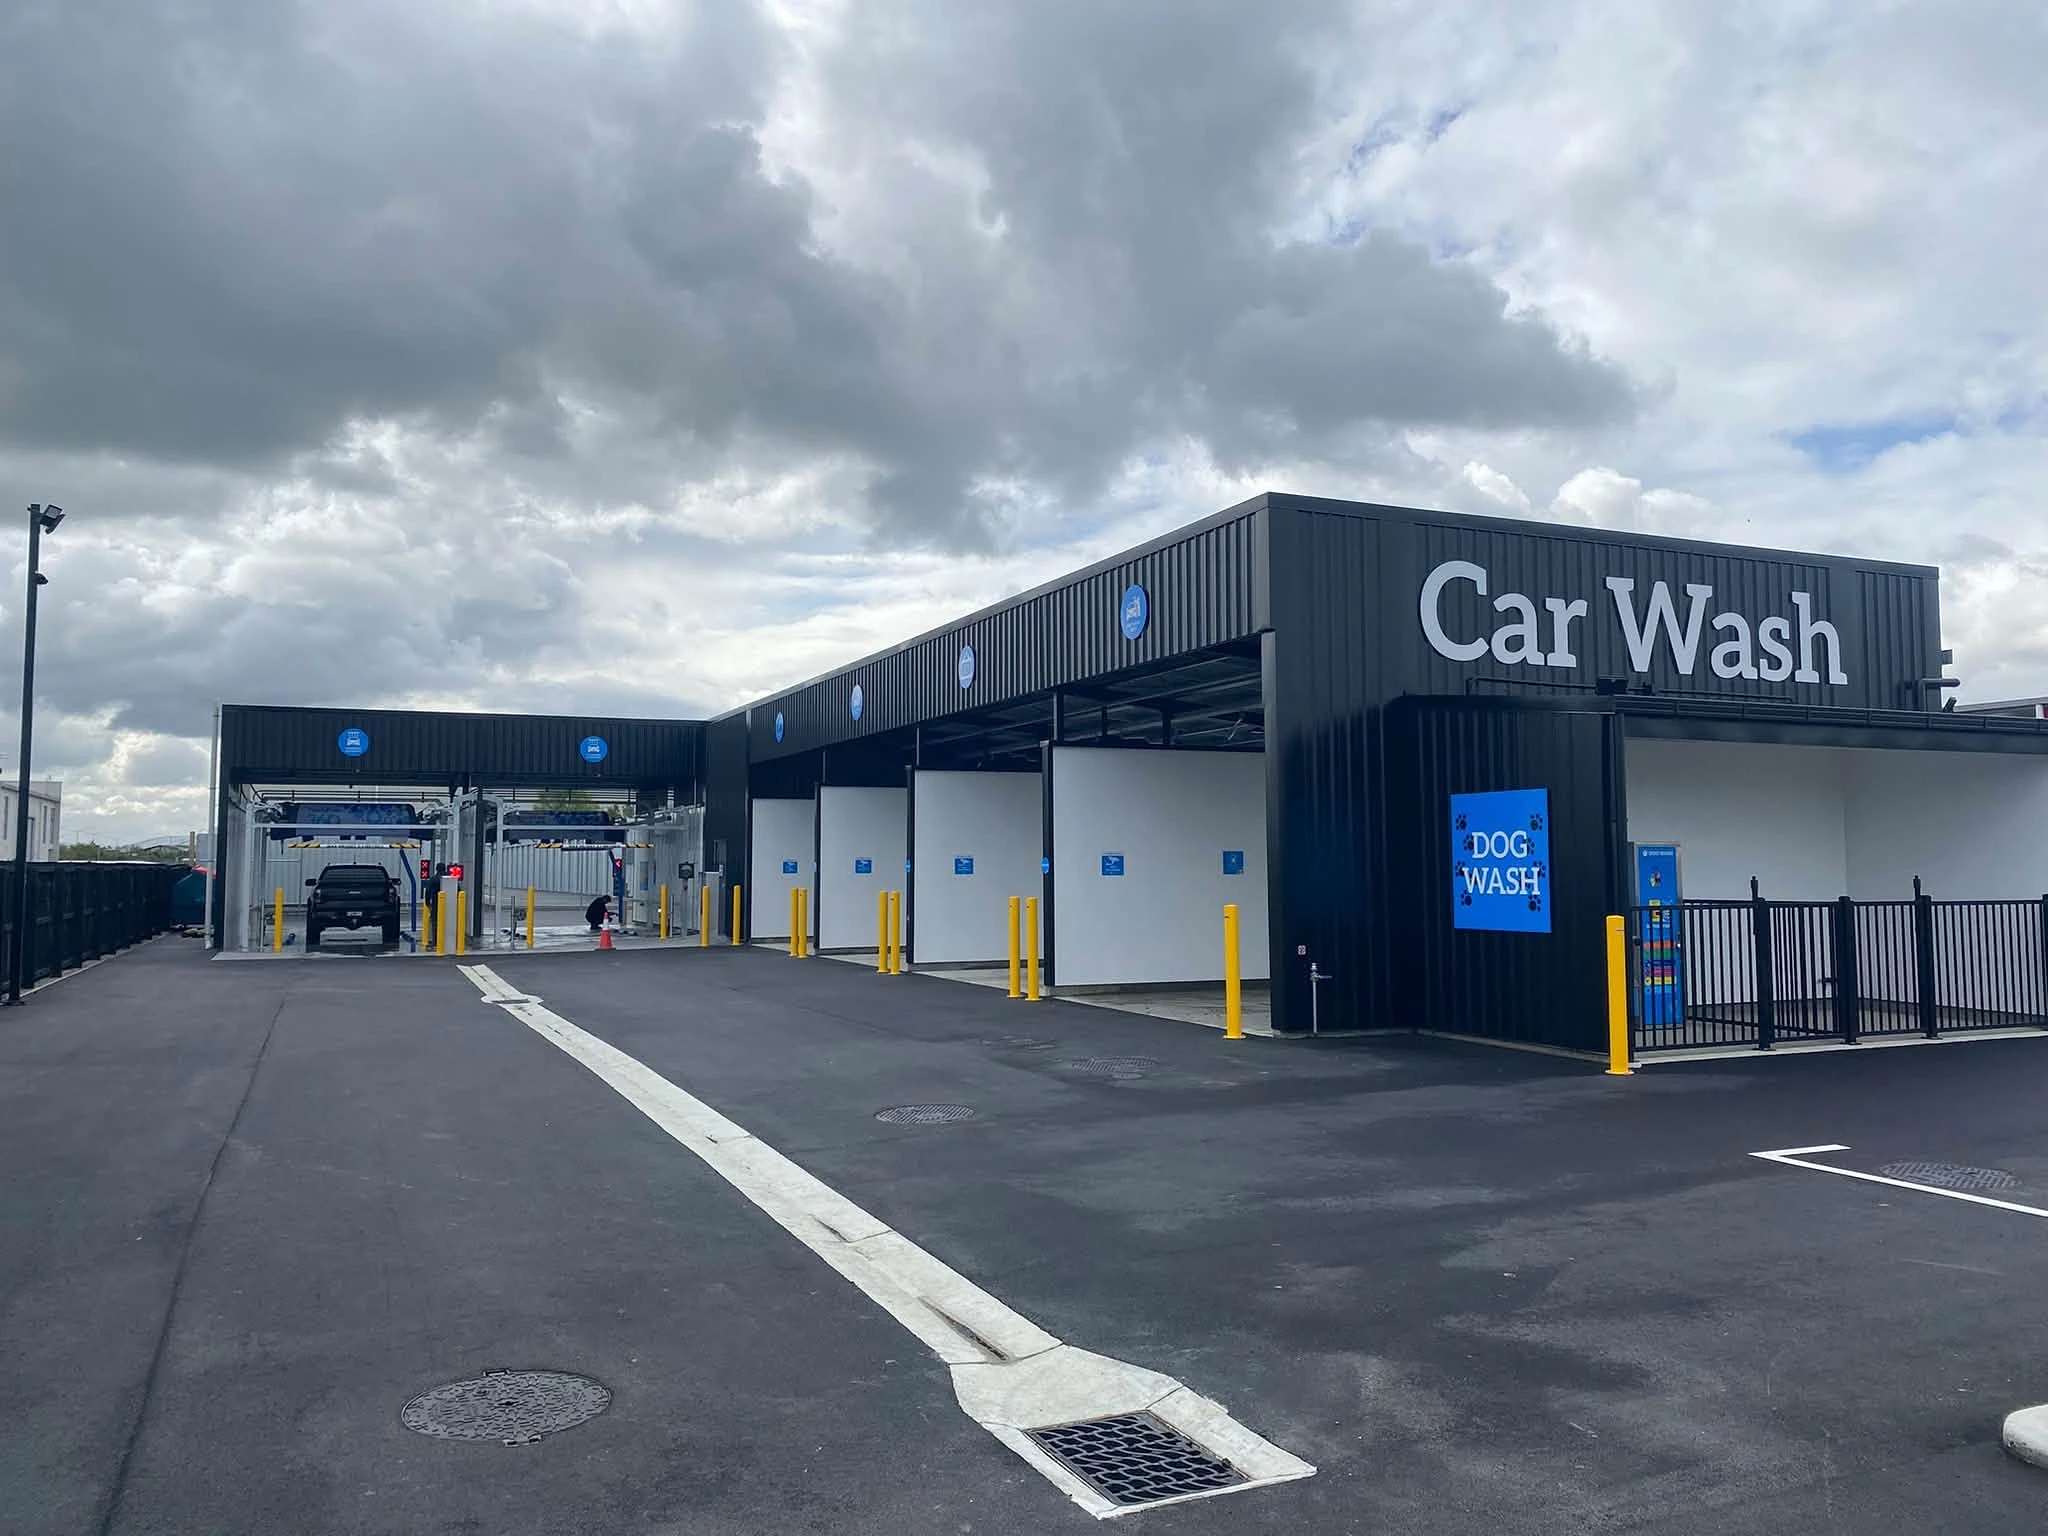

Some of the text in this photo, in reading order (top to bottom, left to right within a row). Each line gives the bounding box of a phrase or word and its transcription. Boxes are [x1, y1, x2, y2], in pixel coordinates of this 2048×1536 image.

[1419, 560, 1848, 685] Car Wash
[1471, 830, 1528, 859] DOG
[1462, 867, 1541, 895] WASH
